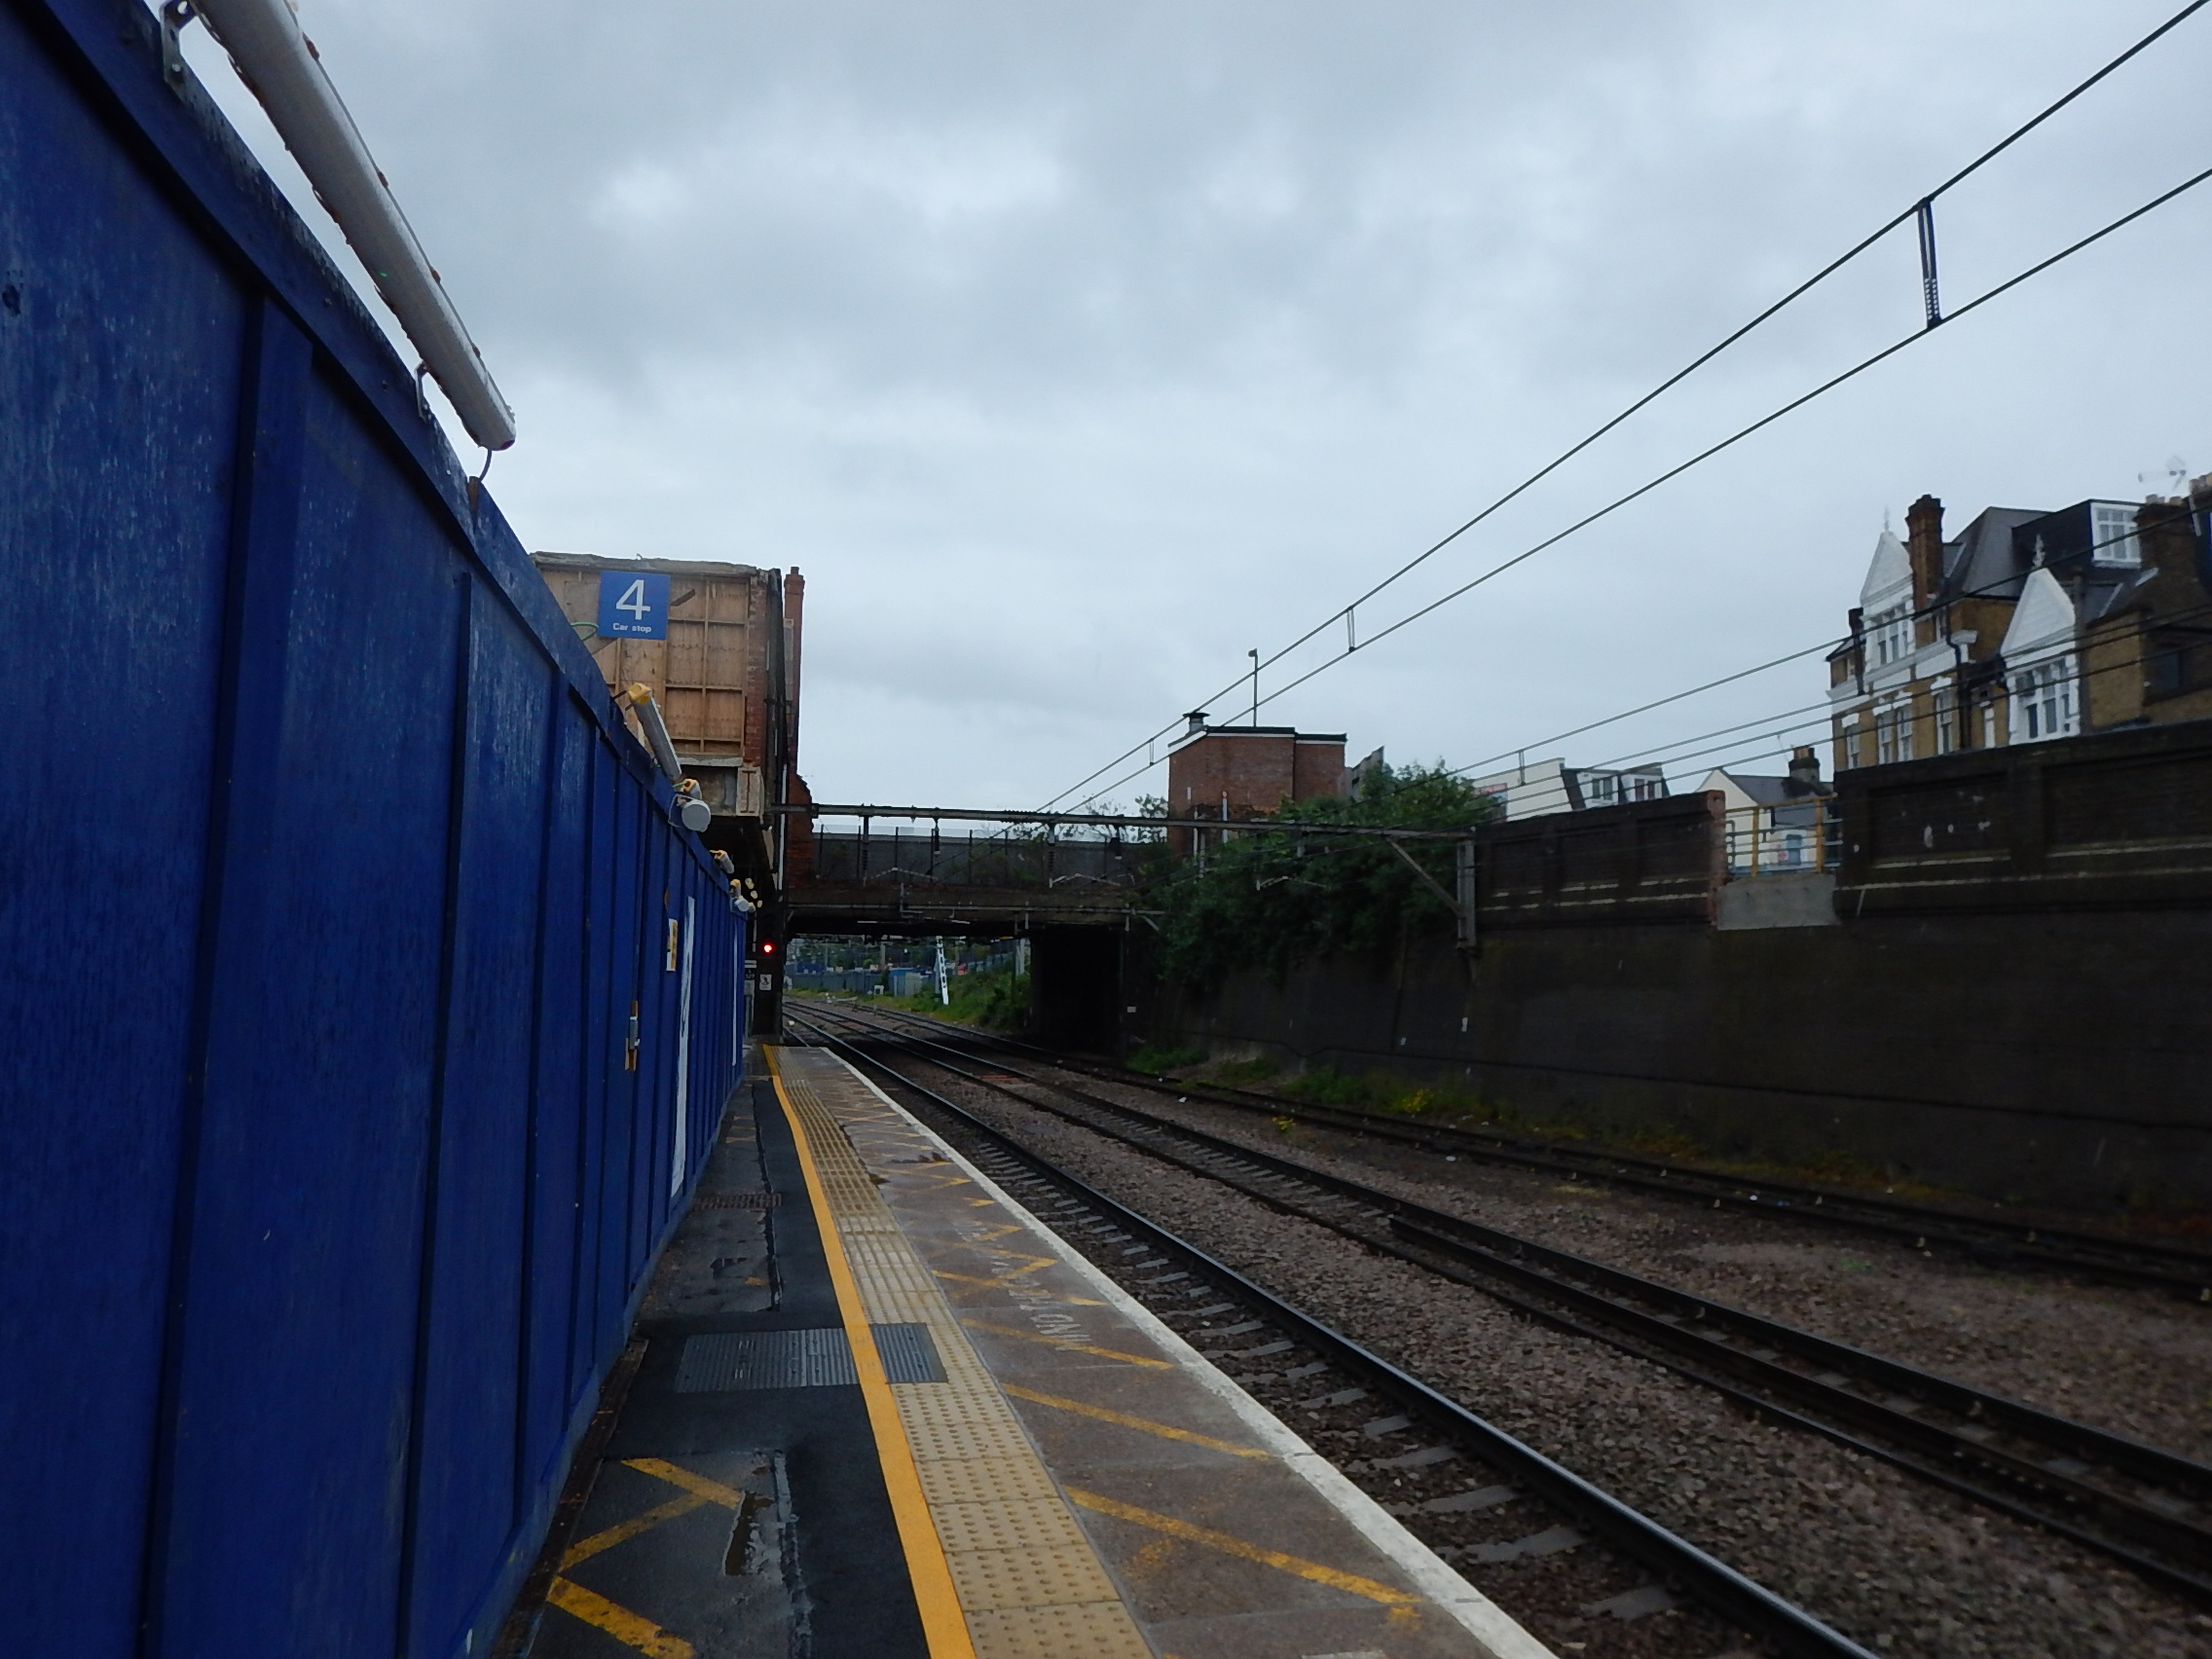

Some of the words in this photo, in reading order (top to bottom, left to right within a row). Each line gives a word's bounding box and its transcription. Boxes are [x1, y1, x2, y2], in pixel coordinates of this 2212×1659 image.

[615, 579, 651, 620] 4
[612, 622, 629, 631] Car
[631, 625, 652, 634] stop
